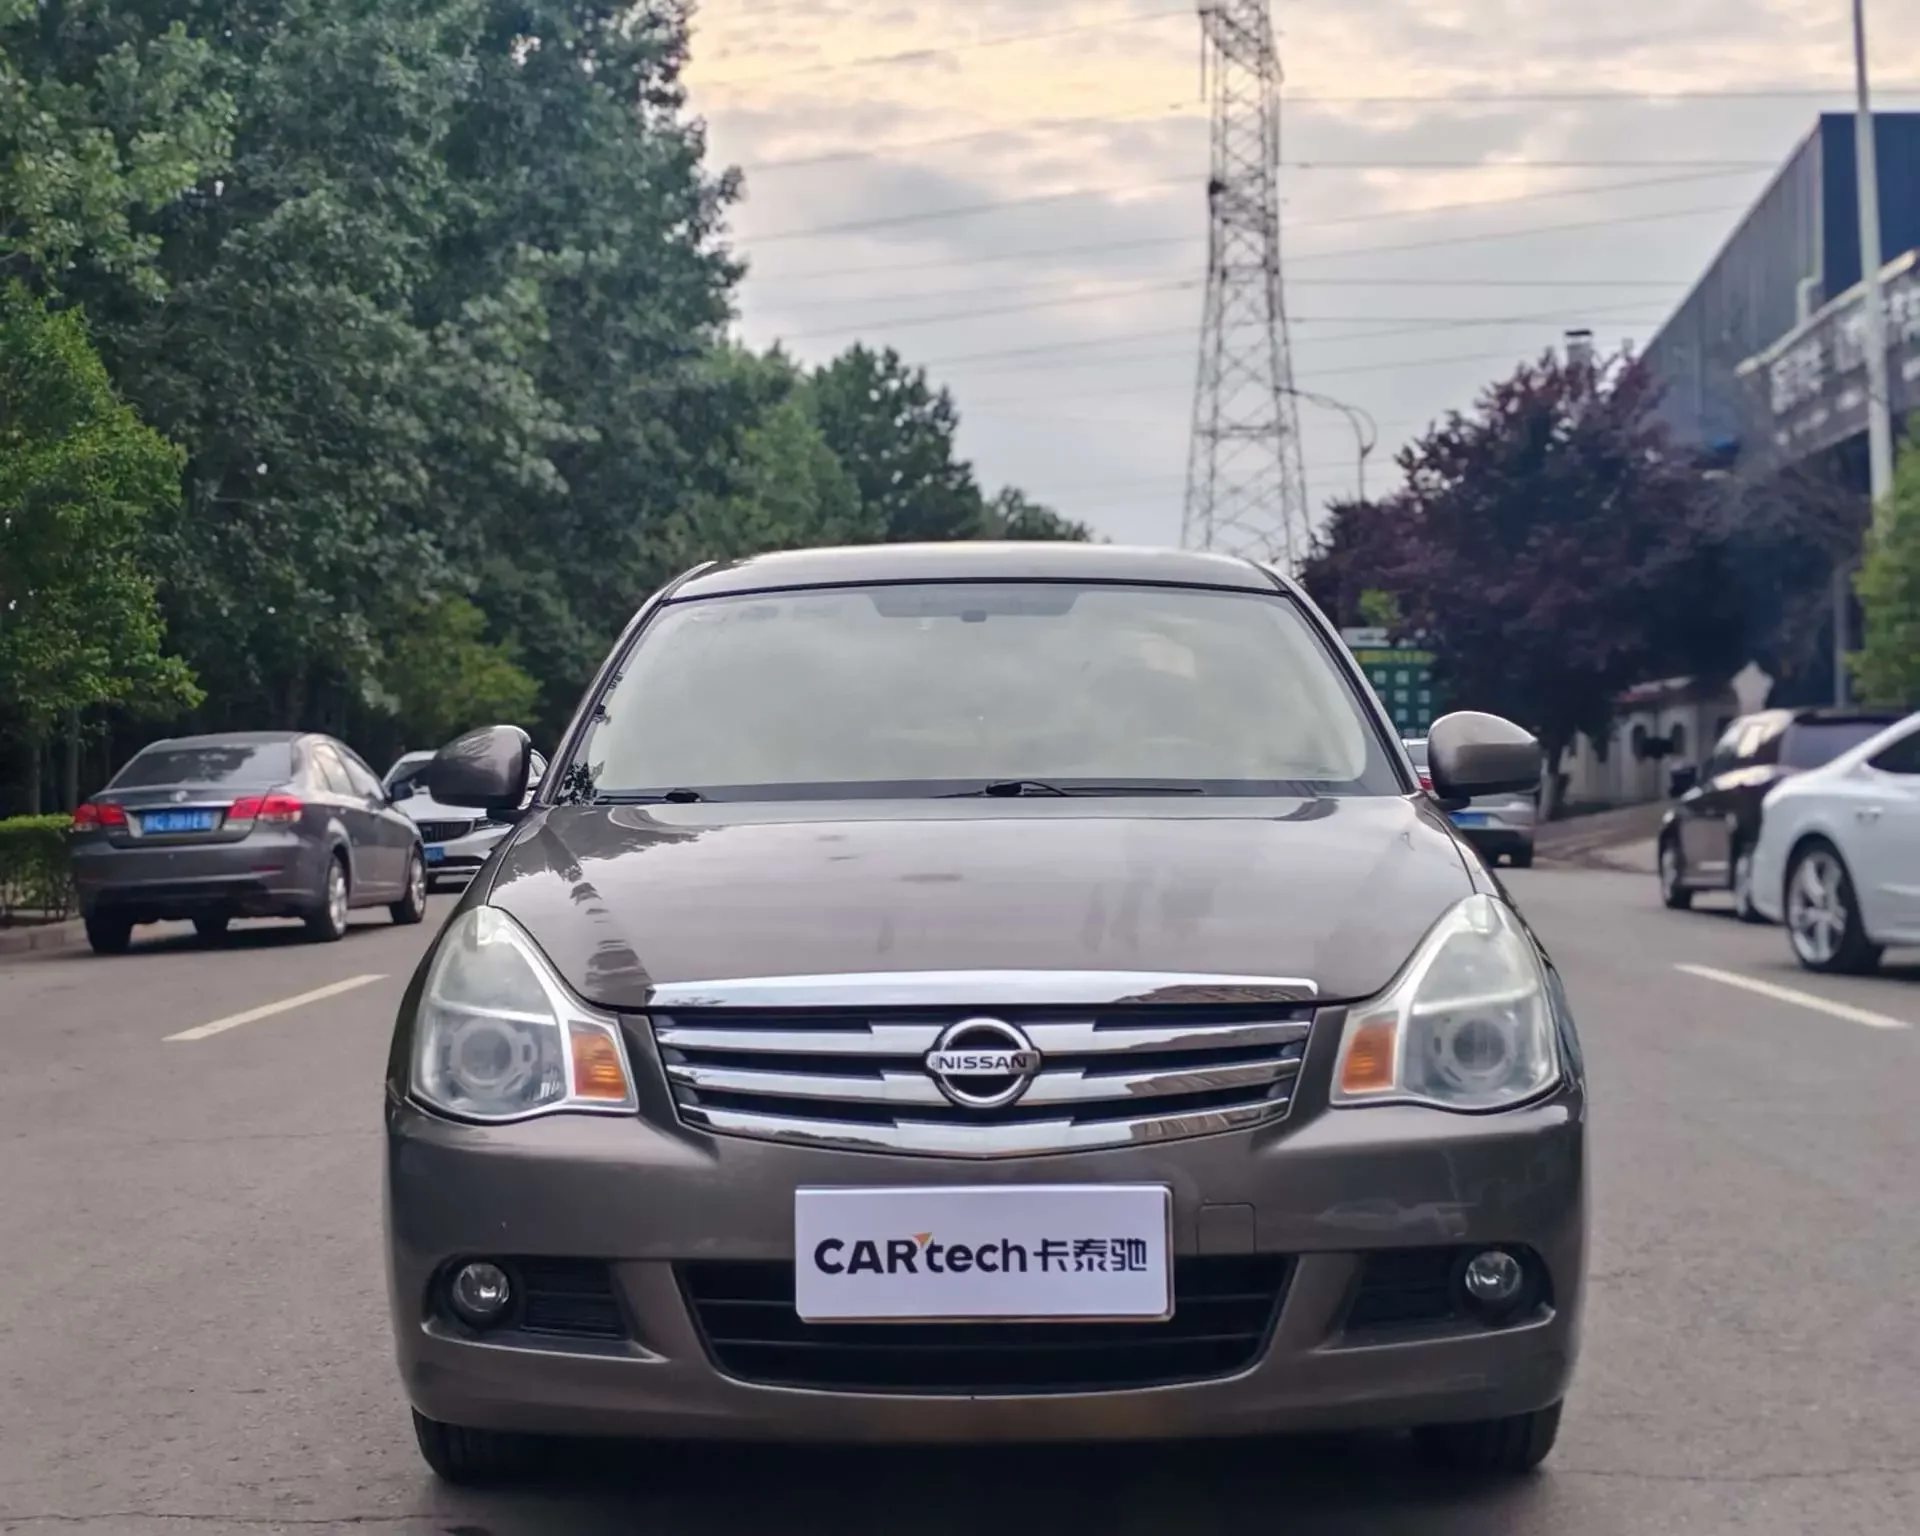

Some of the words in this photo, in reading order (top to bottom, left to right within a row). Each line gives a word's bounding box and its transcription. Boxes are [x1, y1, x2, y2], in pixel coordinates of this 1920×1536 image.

[939, 1055, 1028, 1070] NISSAN
[813, 1236, 1028, 1275] CARtech
[1033, 1238, 1147, 1273] 卡泰驰
